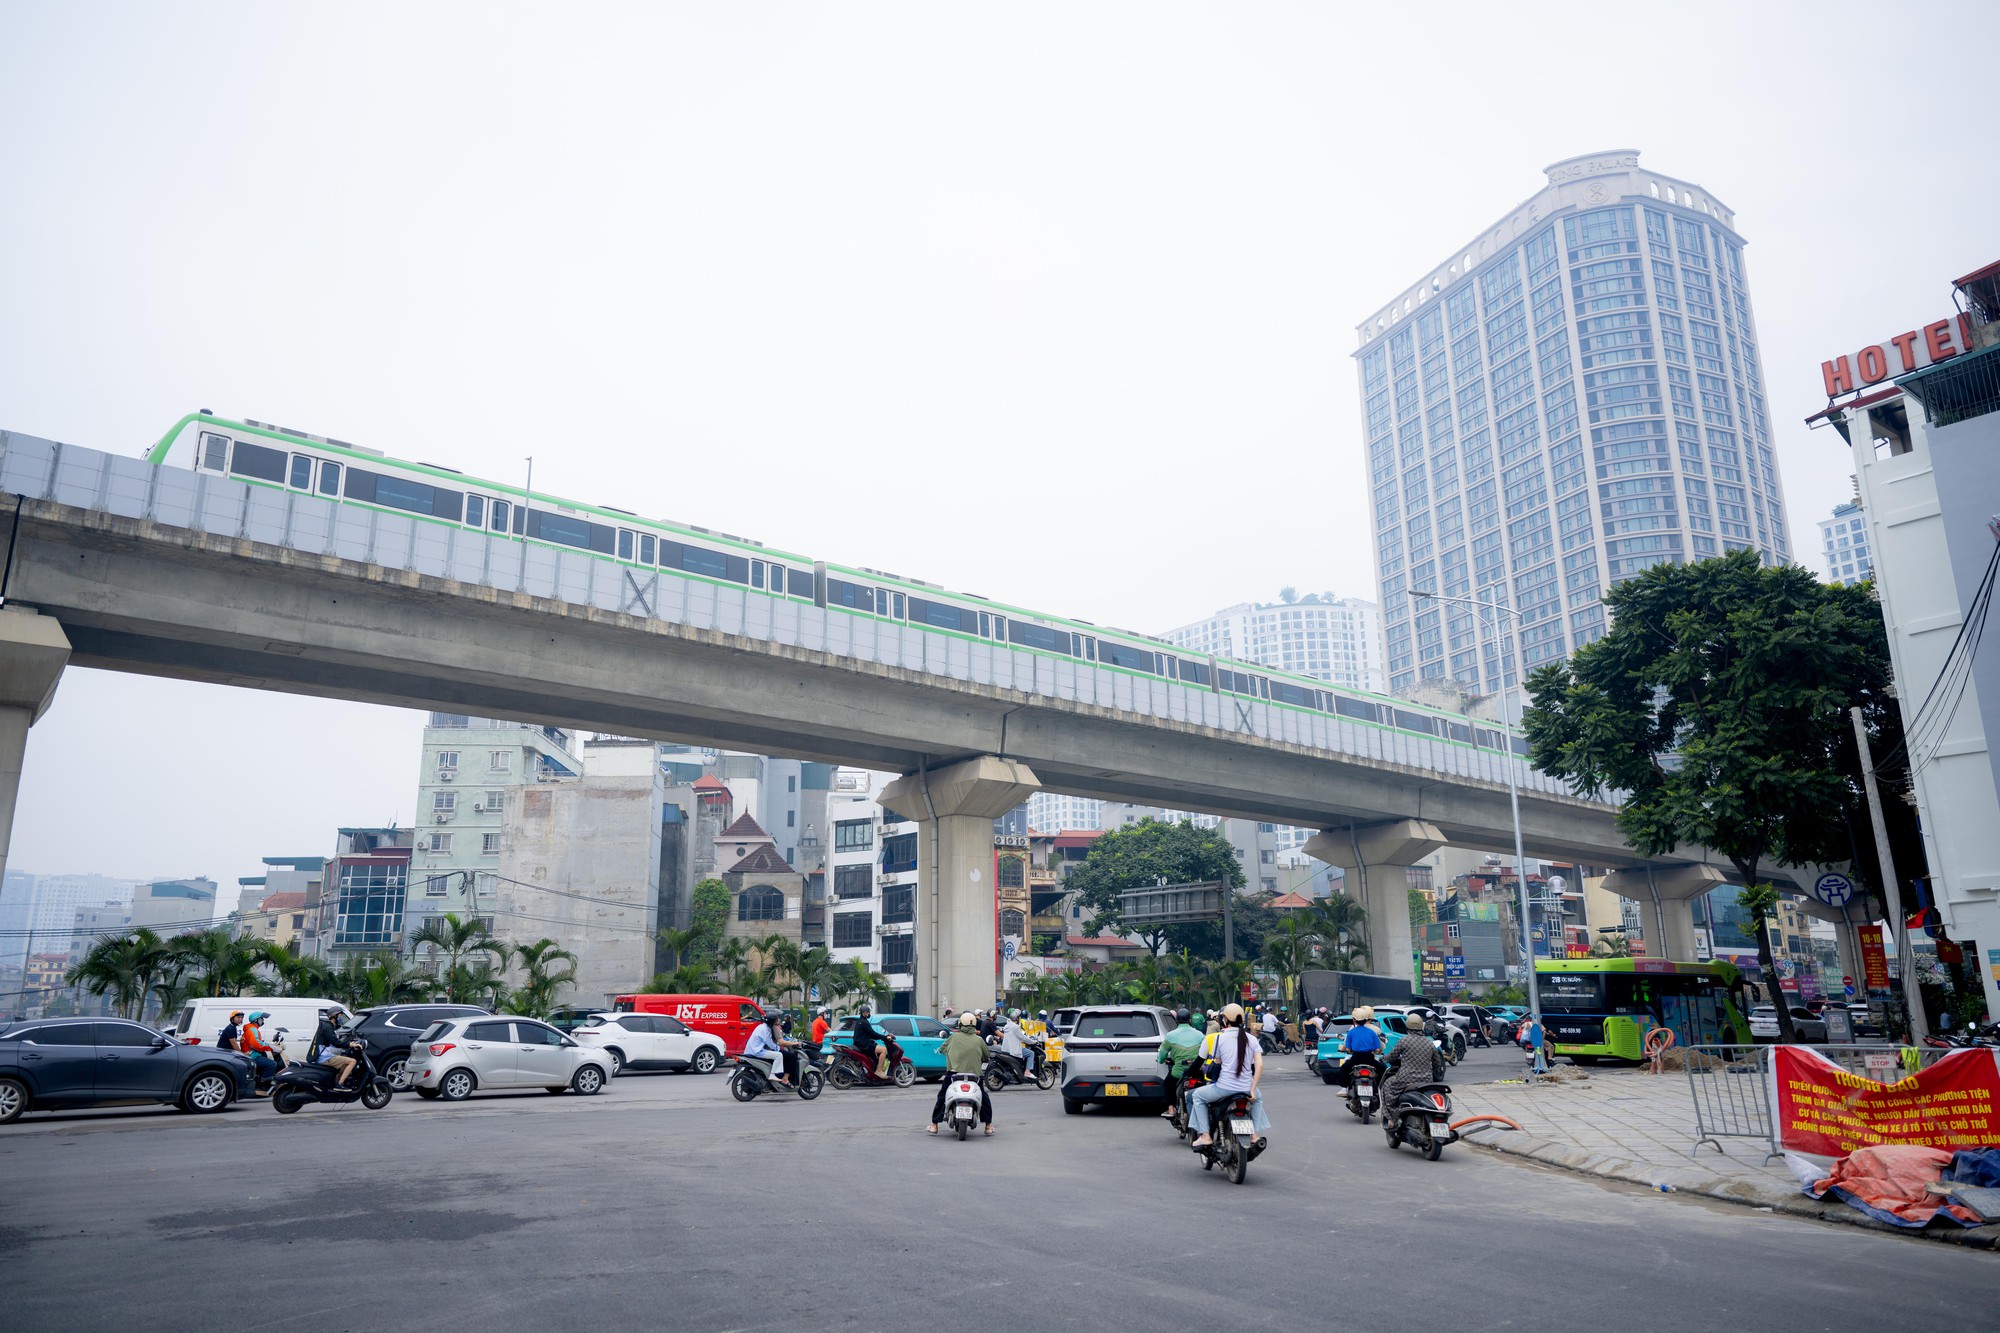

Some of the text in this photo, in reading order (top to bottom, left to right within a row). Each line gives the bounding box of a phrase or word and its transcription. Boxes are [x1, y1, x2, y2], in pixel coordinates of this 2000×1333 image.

[1549, 158, 1640, 184] KING PALACE
[675, 1004, 708, 1019] J&T
[1968, 1088, 1990, 1100] TIỆN
[1791, 1094, 1812, 1105] THAM
[1814, 1098, 1825, 1107] GIA
[1921, 1106, 1950, 1117] TRONG
[1951, 1104, 1970, 1114] KHU
[1890, 1124, 1900, 1133] XE
[1936, 1121, 1948, 1130] 15
[1908, 1137, 1932, 1146] THEO
[1934, 1135, 1947, 1147] SỰ
